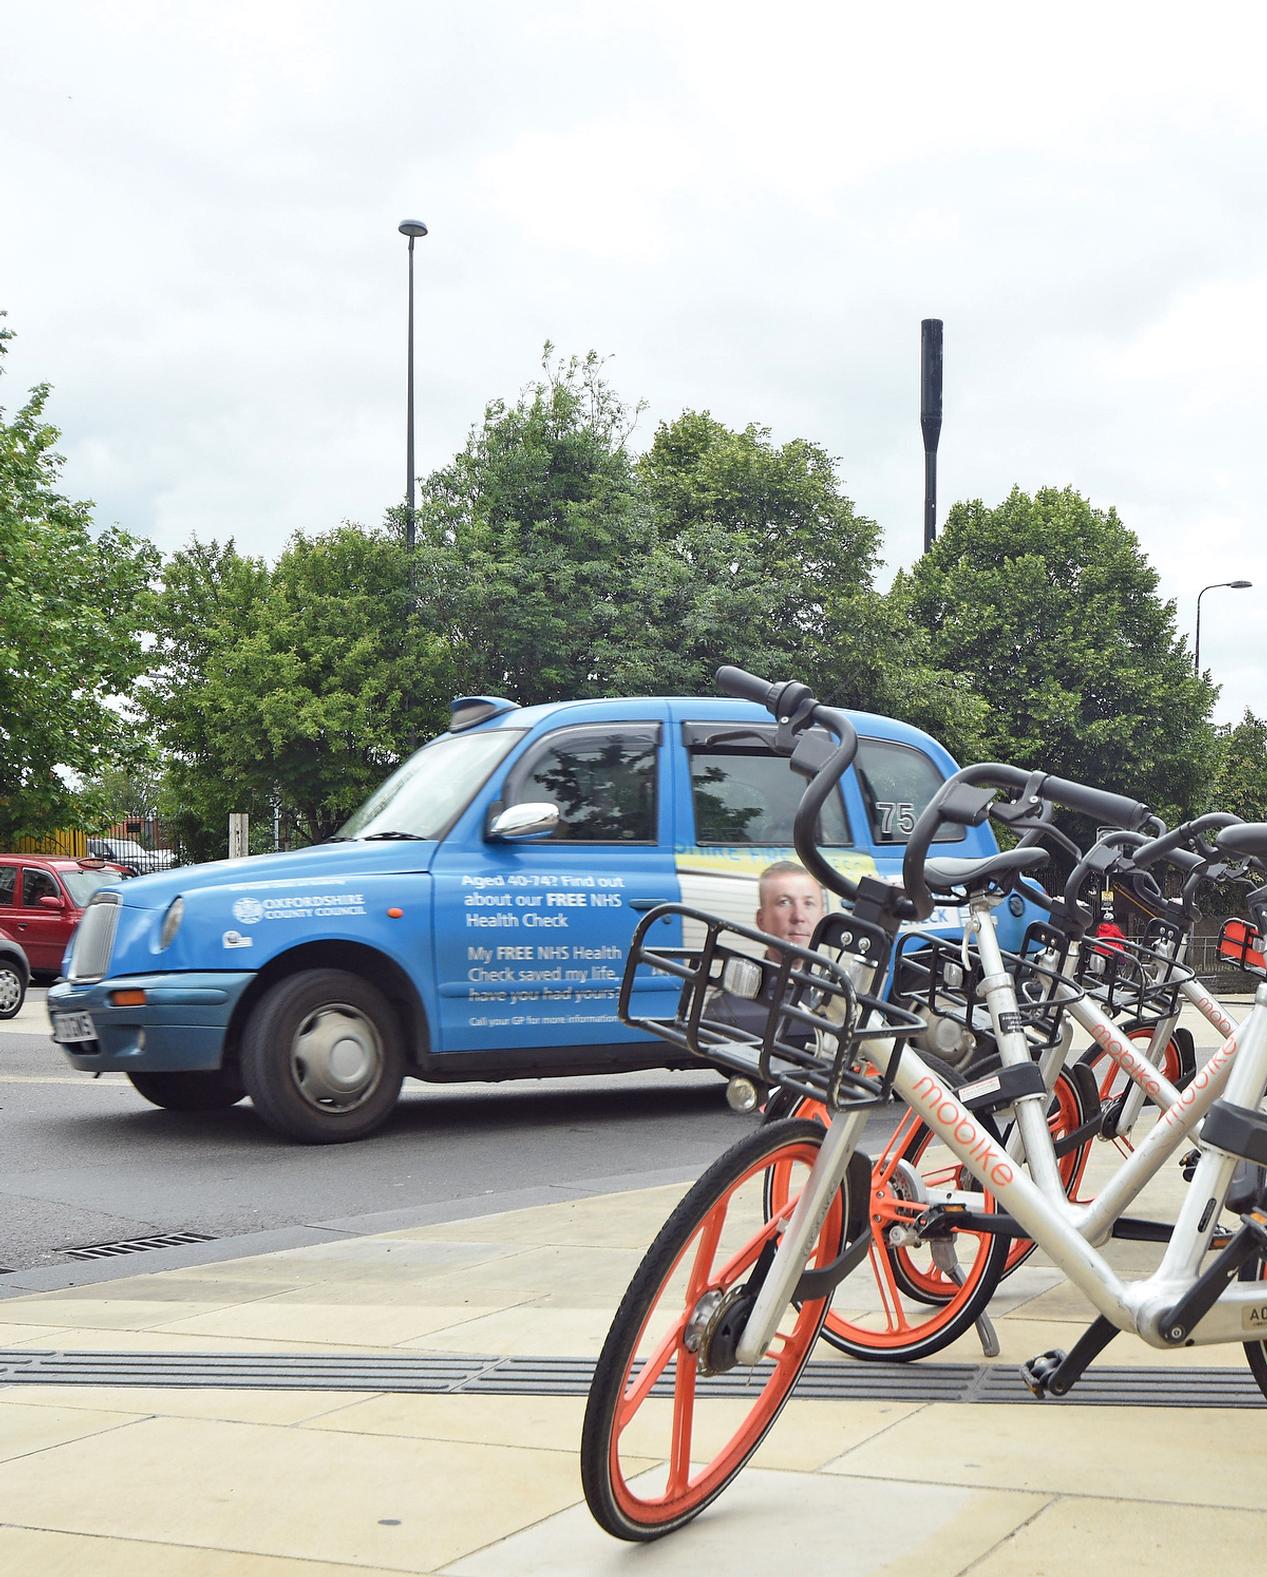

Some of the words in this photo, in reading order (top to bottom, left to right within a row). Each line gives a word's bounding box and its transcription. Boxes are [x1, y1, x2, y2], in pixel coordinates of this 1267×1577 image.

[876, 802, 916, 834] 75
[461, 875, 505, 889] Aged
[508, 875, 558, 886] 40-74?
[560, 875, 595, 887] Find
[597, 876, 625, 887] out
[262, 895, 366, 909] OXFORDSHIRE
[464, 892, 513, 906] about
[515, 894, 543, 906] our
[546, 893, 587, 907] FREE
[590, 893, 622, 907] NHS
[263, 908, 314, 919] COUNTY
[314, 906, 367, 917] COUNCIL
[466, 912, 519, 927] Health
[522, 912, 568, 927] Check
[467, 946, 493, 963] My
[497, 946, 534, 960] FREE
[537, 946, 569, 960] NHS
[573, 945, 622, 960] Health
[468, 966, 515, 982] Check
[518, 966, 562, 981] saved
[565, 969, 588, 983] my
[591, 965, 620, 981] life,
[469, 987, 508, 1001] have
[510, 990, 540, 1004] you
[543, 986, 572, 1000] had
[574, 986, 621, 1003] yours?
[469, 1016, 488, 1026] Call
[488, 1018, 510, 1028] your
[511, 1016, 525, 1025] GP
[526, 1015, 541, 1025] for
[1091, 1023, 1161, 1097] mobike
[1164, 1036, 1238, 1127] mobike
[912, 1075, 1016, 1188] mobike
